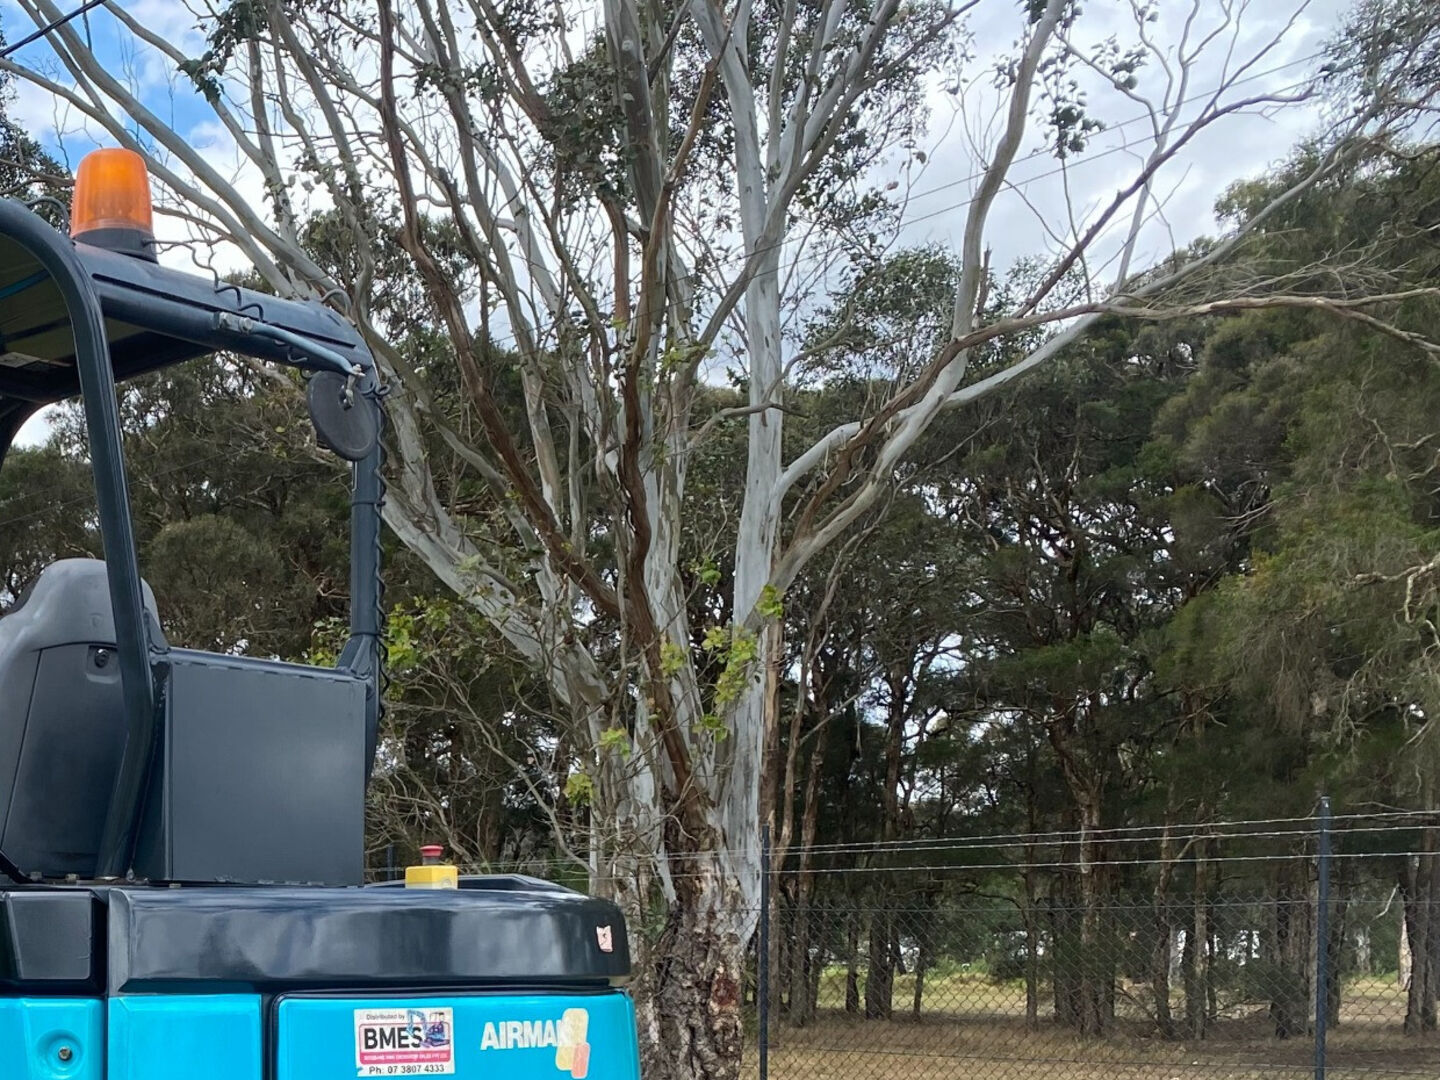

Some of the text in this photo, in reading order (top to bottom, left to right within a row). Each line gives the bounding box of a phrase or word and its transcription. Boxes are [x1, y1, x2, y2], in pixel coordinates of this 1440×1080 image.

[364, 1026, 423, 1049] BMES
[387, 1065, 399, 1074] 07
[400, 1065, 422, 1074] 3807
[424, 1064, 445, 1073] 4333
